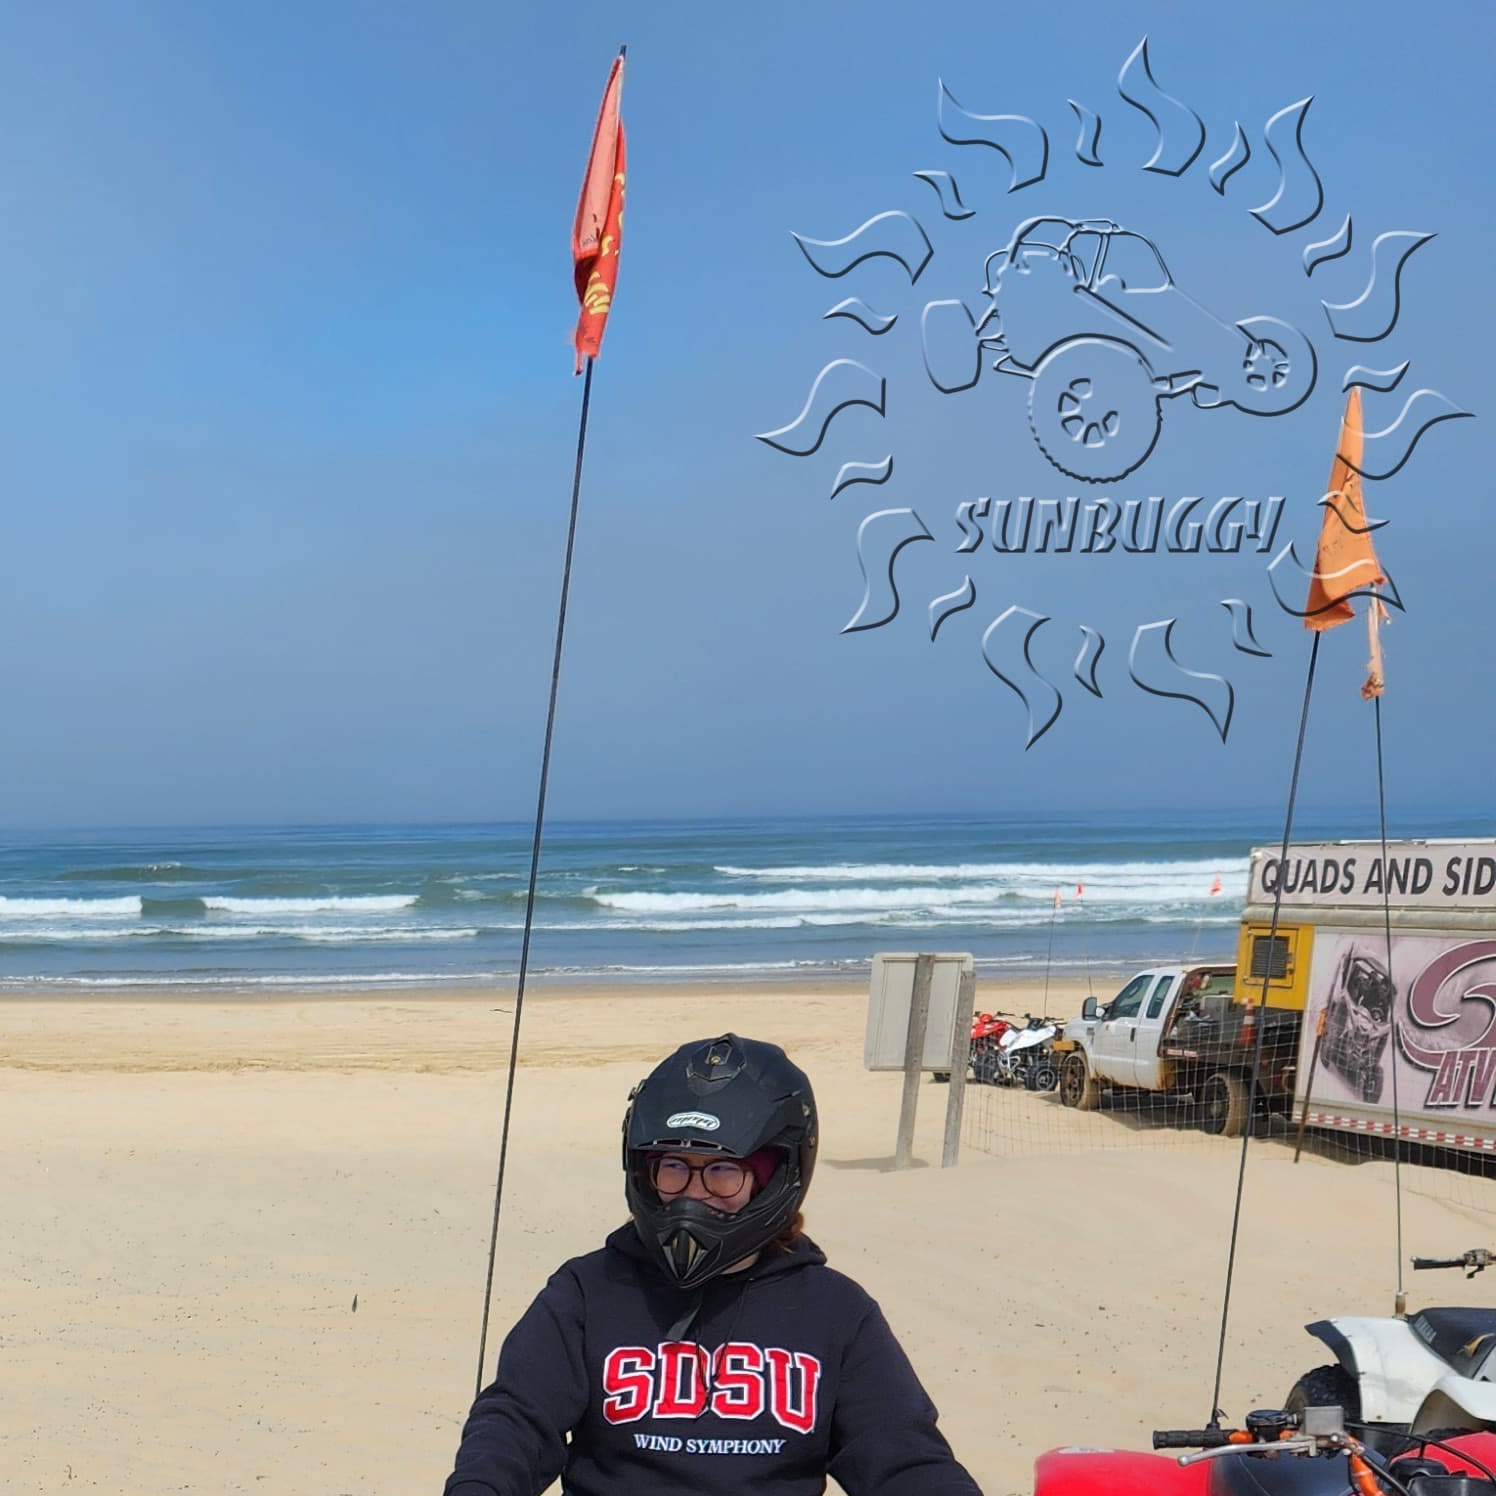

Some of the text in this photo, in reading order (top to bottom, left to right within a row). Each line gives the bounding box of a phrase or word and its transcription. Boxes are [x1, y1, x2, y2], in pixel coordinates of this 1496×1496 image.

[1261, 857, 1356, 897] QUADS
[1364, 857, 1433, 896] AND
[602, 1341, 822, 1436] SDSU
[633, 1434, 786, 1456] WIND SYMPHONY
